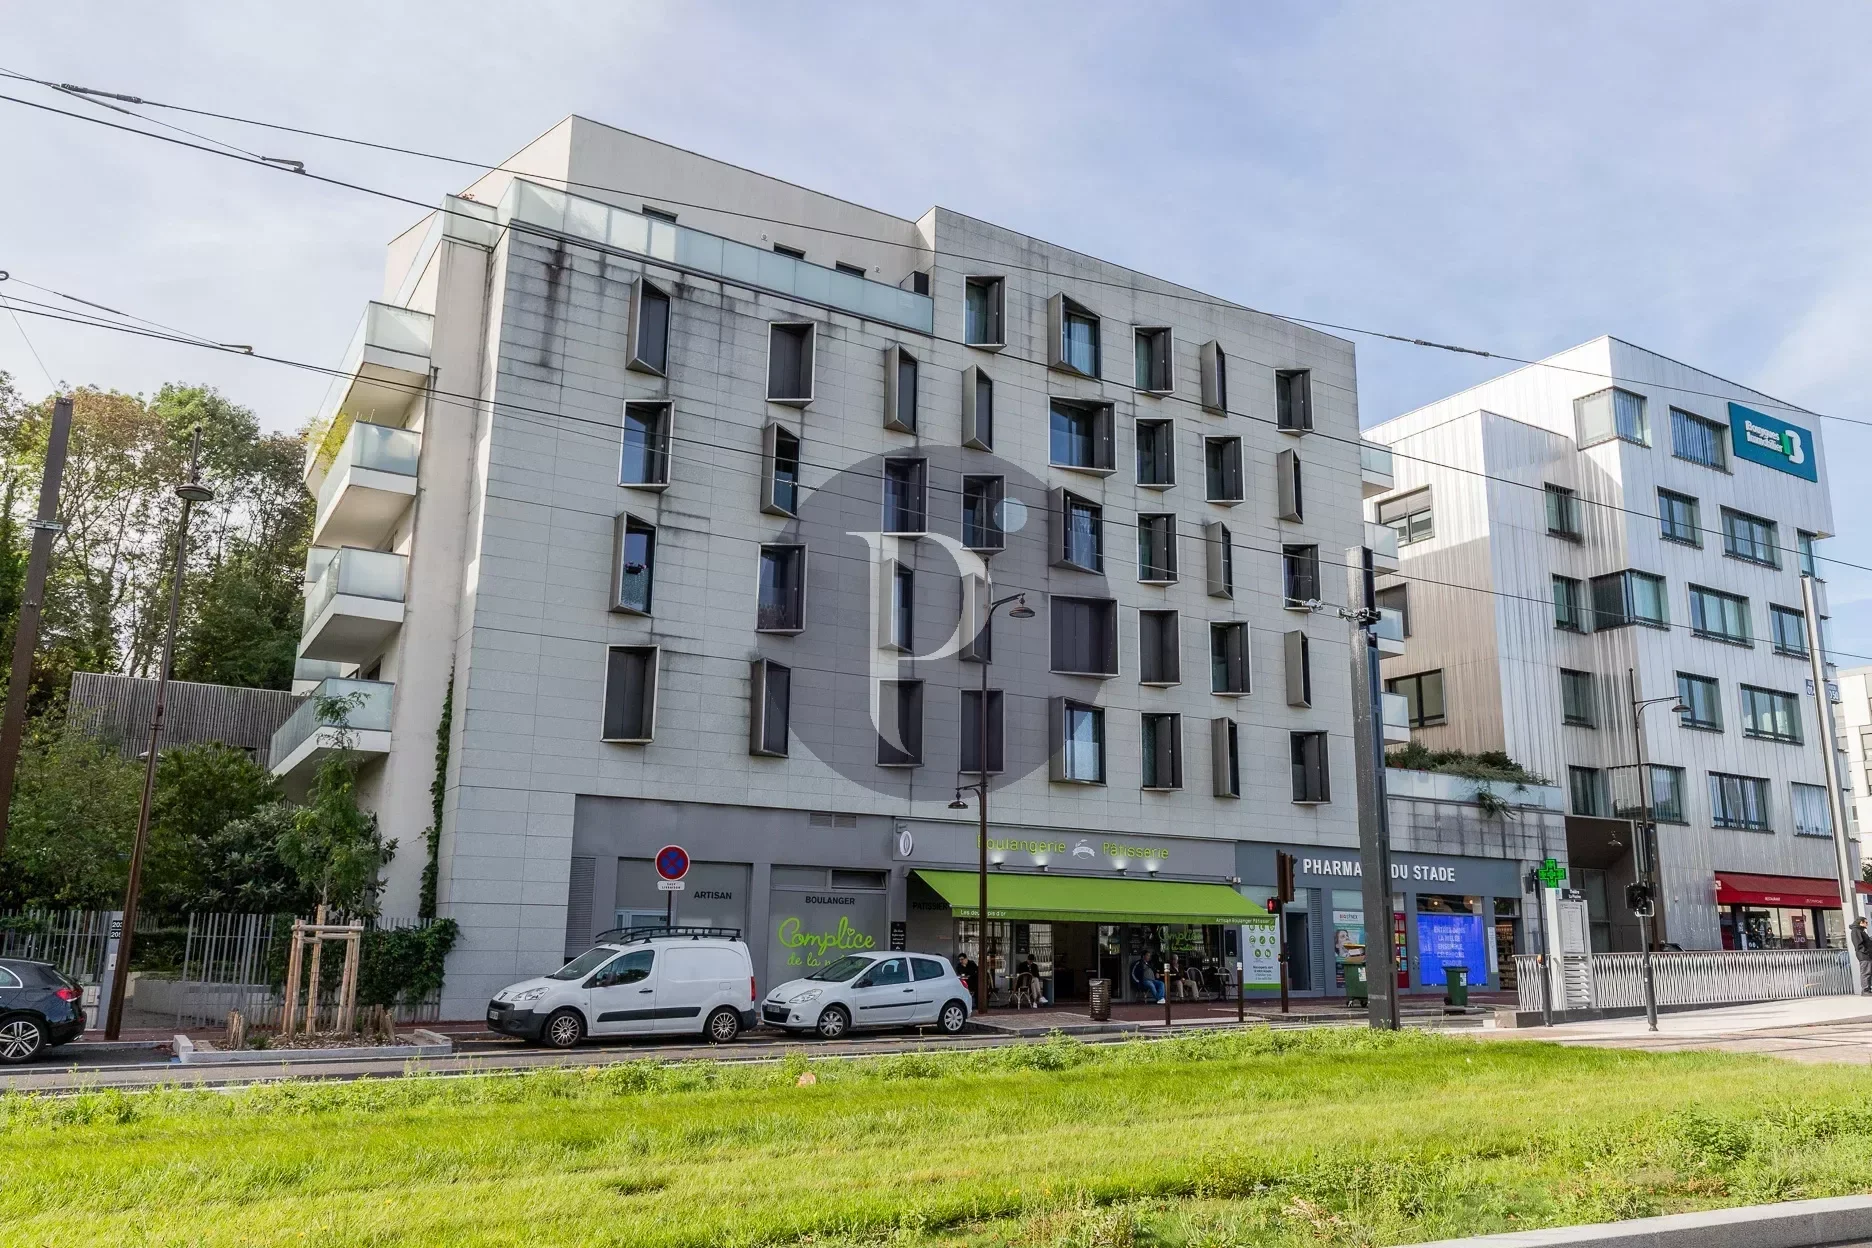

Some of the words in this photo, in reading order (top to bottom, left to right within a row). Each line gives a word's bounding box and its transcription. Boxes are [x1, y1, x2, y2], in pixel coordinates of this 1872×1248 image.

[1103, 842, 1169, 859] Pâtisserie
[1303, 858, 1363, 877] PHARMA
[1391, 864, 1408, 879] DU
[1413, 865, 1455, 882] STADE
[694, 891, 732, 900] ARTISAN
[805, 896, 855, 905] BOULANGER
[778, 916, 876, 956] Complice
[787, 952, 802, 966] de
[807, 952, 820, 967] la
